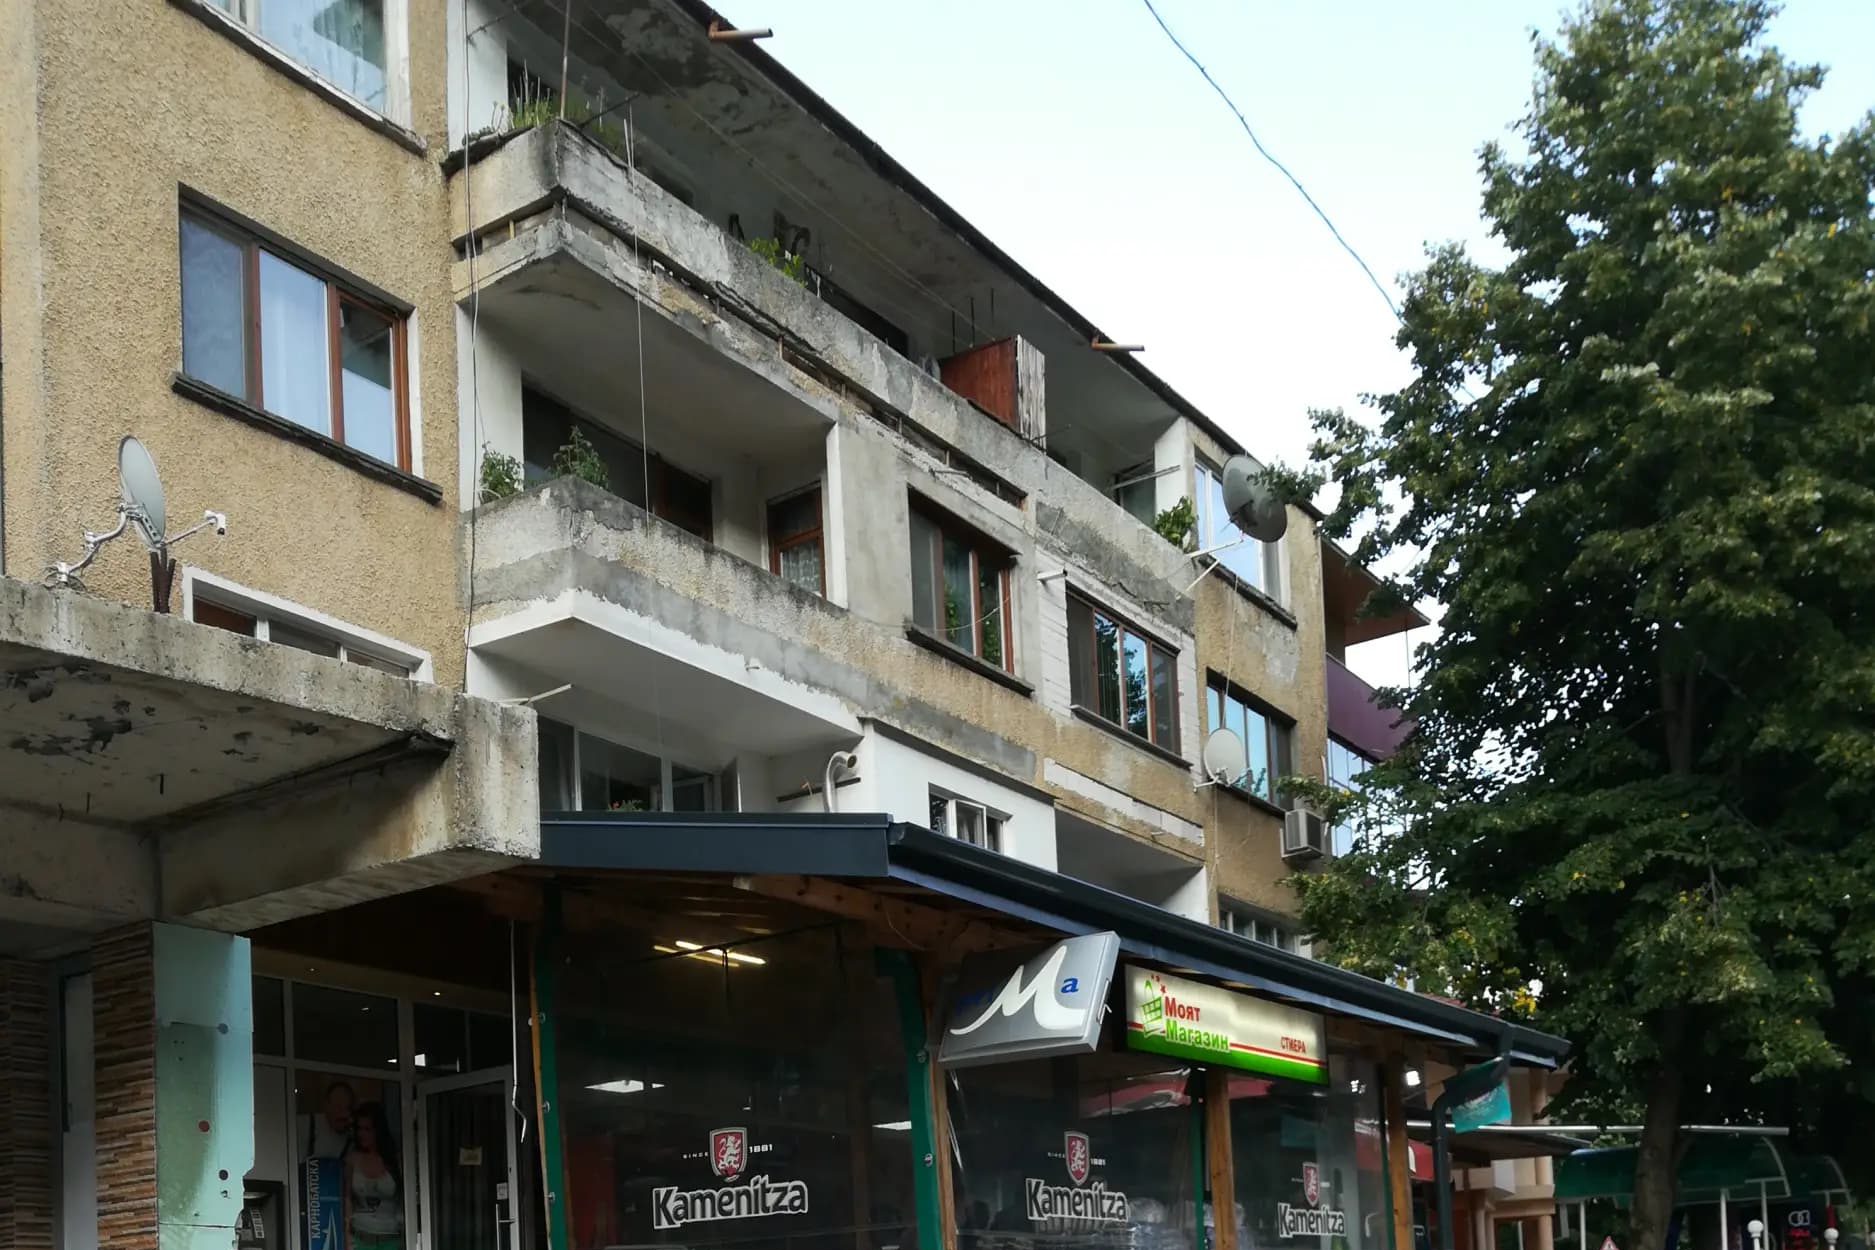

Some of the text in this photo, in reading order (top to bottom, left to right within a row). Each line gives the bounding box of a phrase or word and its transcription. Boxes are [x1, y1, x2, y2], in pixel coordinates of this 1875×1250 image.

[1165, 996, 1200, 1021] Моят
[1165, 1018, 1230, 1051] Магазин
[310, 1158, 320, 1239] КАРНОБАТСКА
[652, 1174, 808, 1229] Kamenitza
[1025, 1177, 1128, 1222] Kamenitza
[1277, 1202, 1346, 1238] Kamenitza
